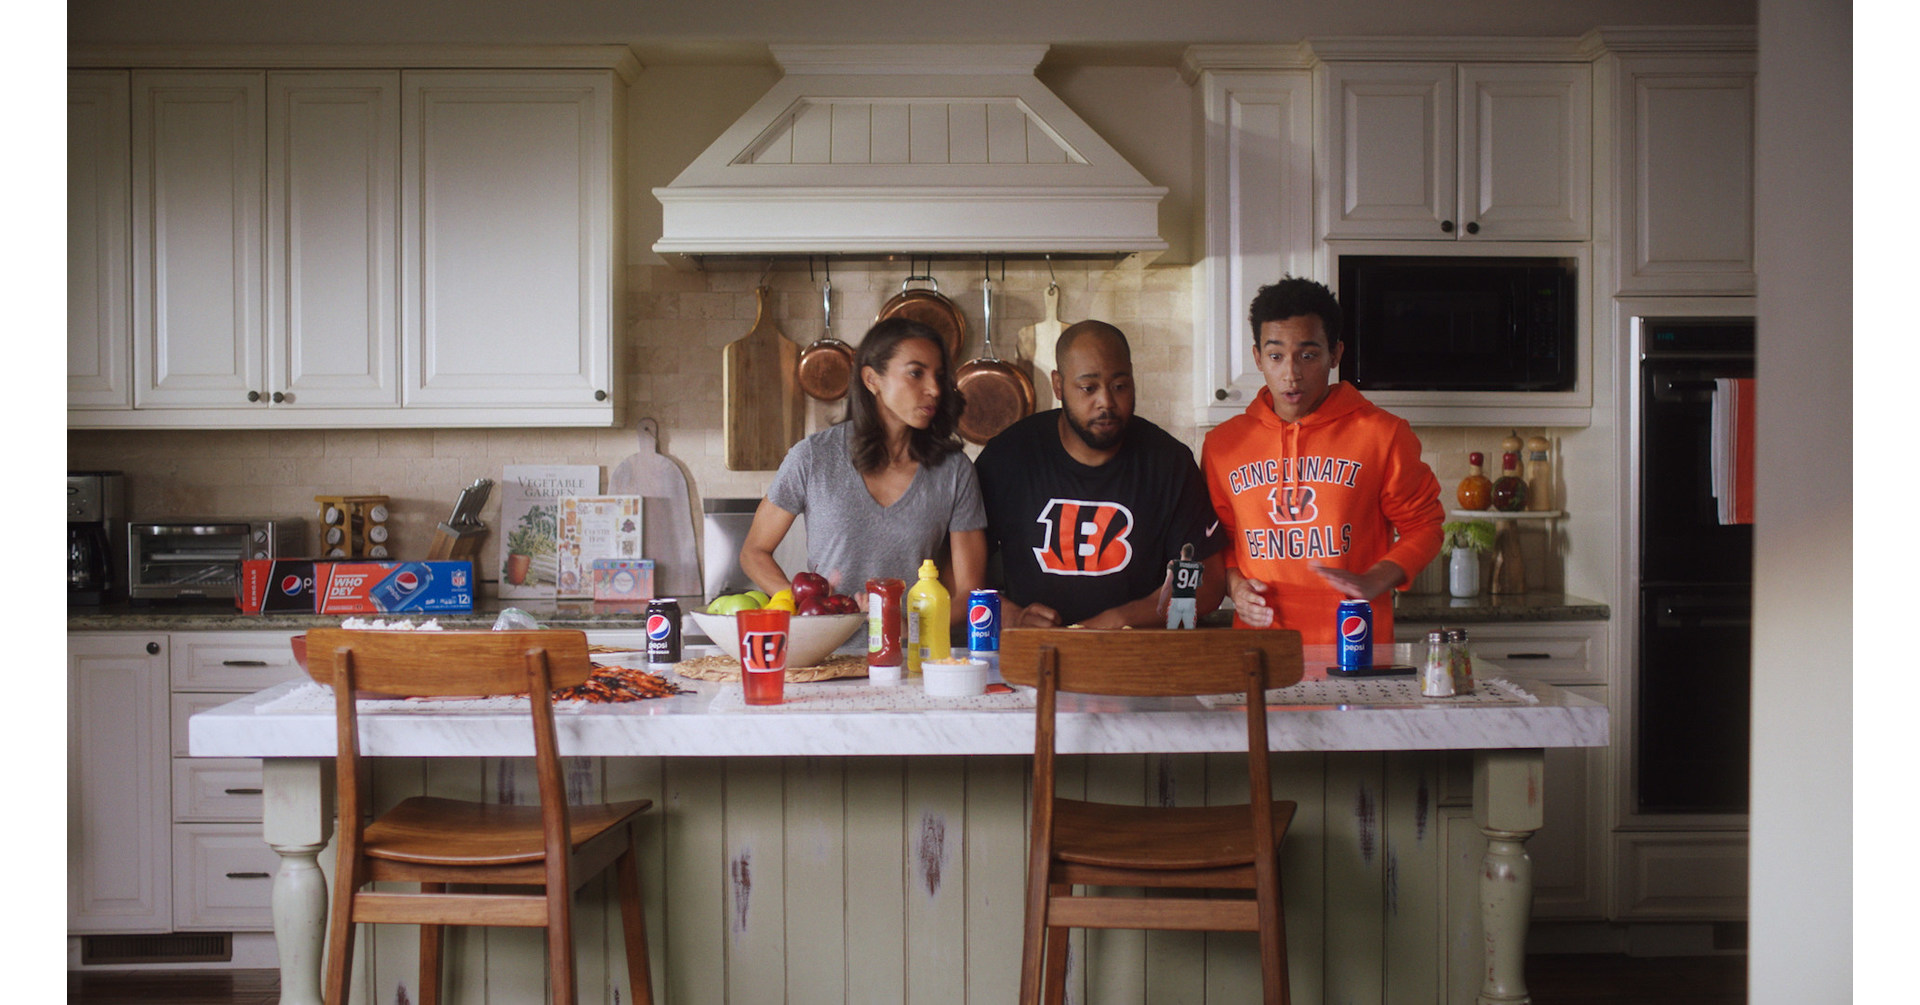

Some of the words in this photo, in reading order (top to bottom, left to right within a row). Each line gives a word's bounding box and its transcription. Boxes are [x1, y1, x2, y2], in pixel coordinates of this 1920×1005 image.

[1229, 456, 1363, 495] CINCINNATI
[518, 476, 585, 488] VEGETABLE
[525, 488, 575, 497] GARDEN
[1244, 523, 1352, 560] BENGALS
[334, 577, 363, 587] WHO
[1177, 568, 1199, 590] 94
[331, 587, 355, 596] DEY
[971, 630, 990, 639] pepsi
[648, 640, 668, 650] pepsi
[1344, 643, 1365, 653] pepsi
